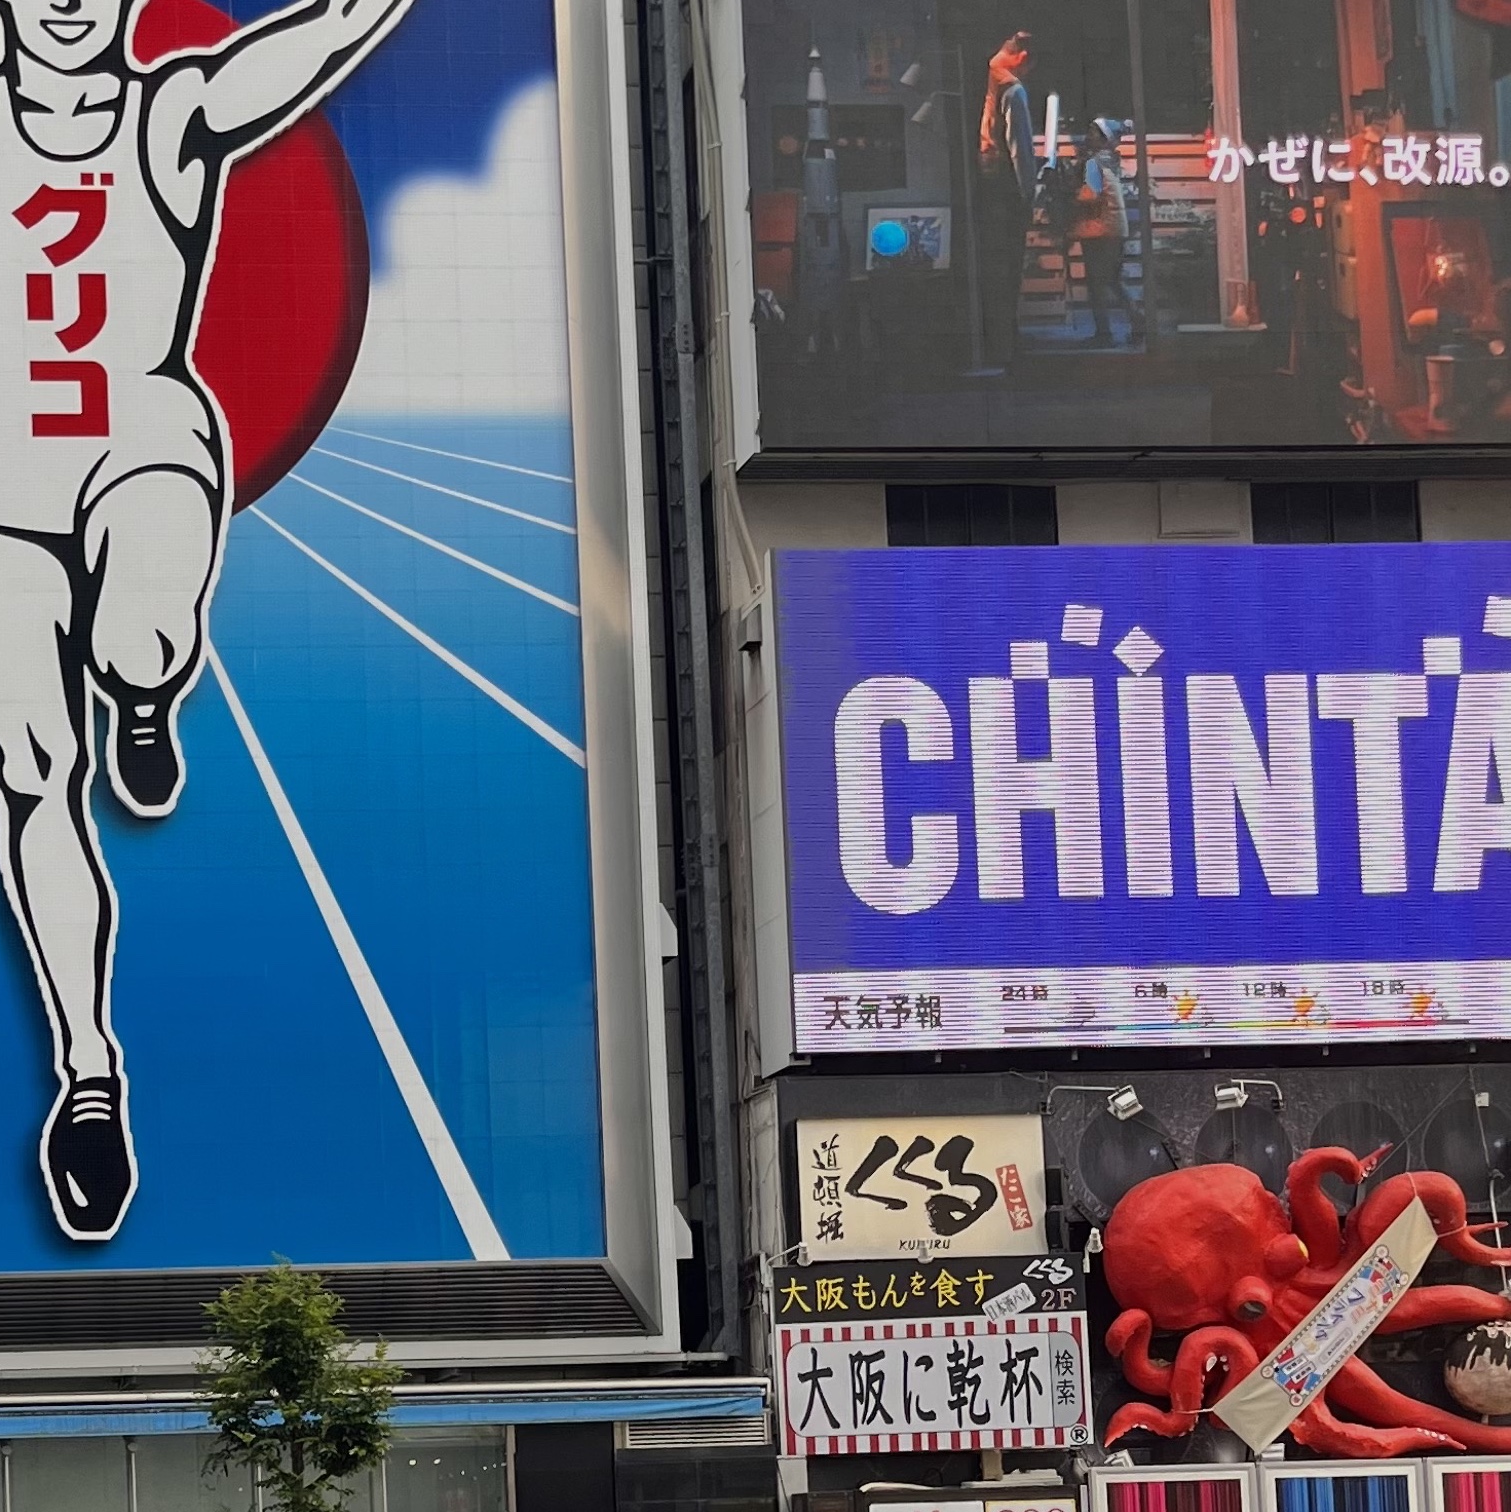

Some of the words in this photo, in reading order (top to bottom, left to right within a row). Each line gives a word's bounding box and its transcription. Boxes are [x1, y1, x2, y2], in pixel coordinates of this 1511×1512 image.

[1206, 134, 1510, 189] かぜに、改源。
[12, 173, 116, 438] グリコ
[823, 994, 943, 1030] 天気予報
[811, 1134, 844, 1243] 道頓堀
[845, 1135, 998, 1236] くくる
[780, 1268, 995, 1314] 大阪もんを食す
[1023, 1258, 1074, 1285] くくる
[1041, 1288, 1077, 1311] 2F
[798, 1338, 1044, 1431] 大阪に乾杯
[1054, 1349, 1076, 1406] 検索
